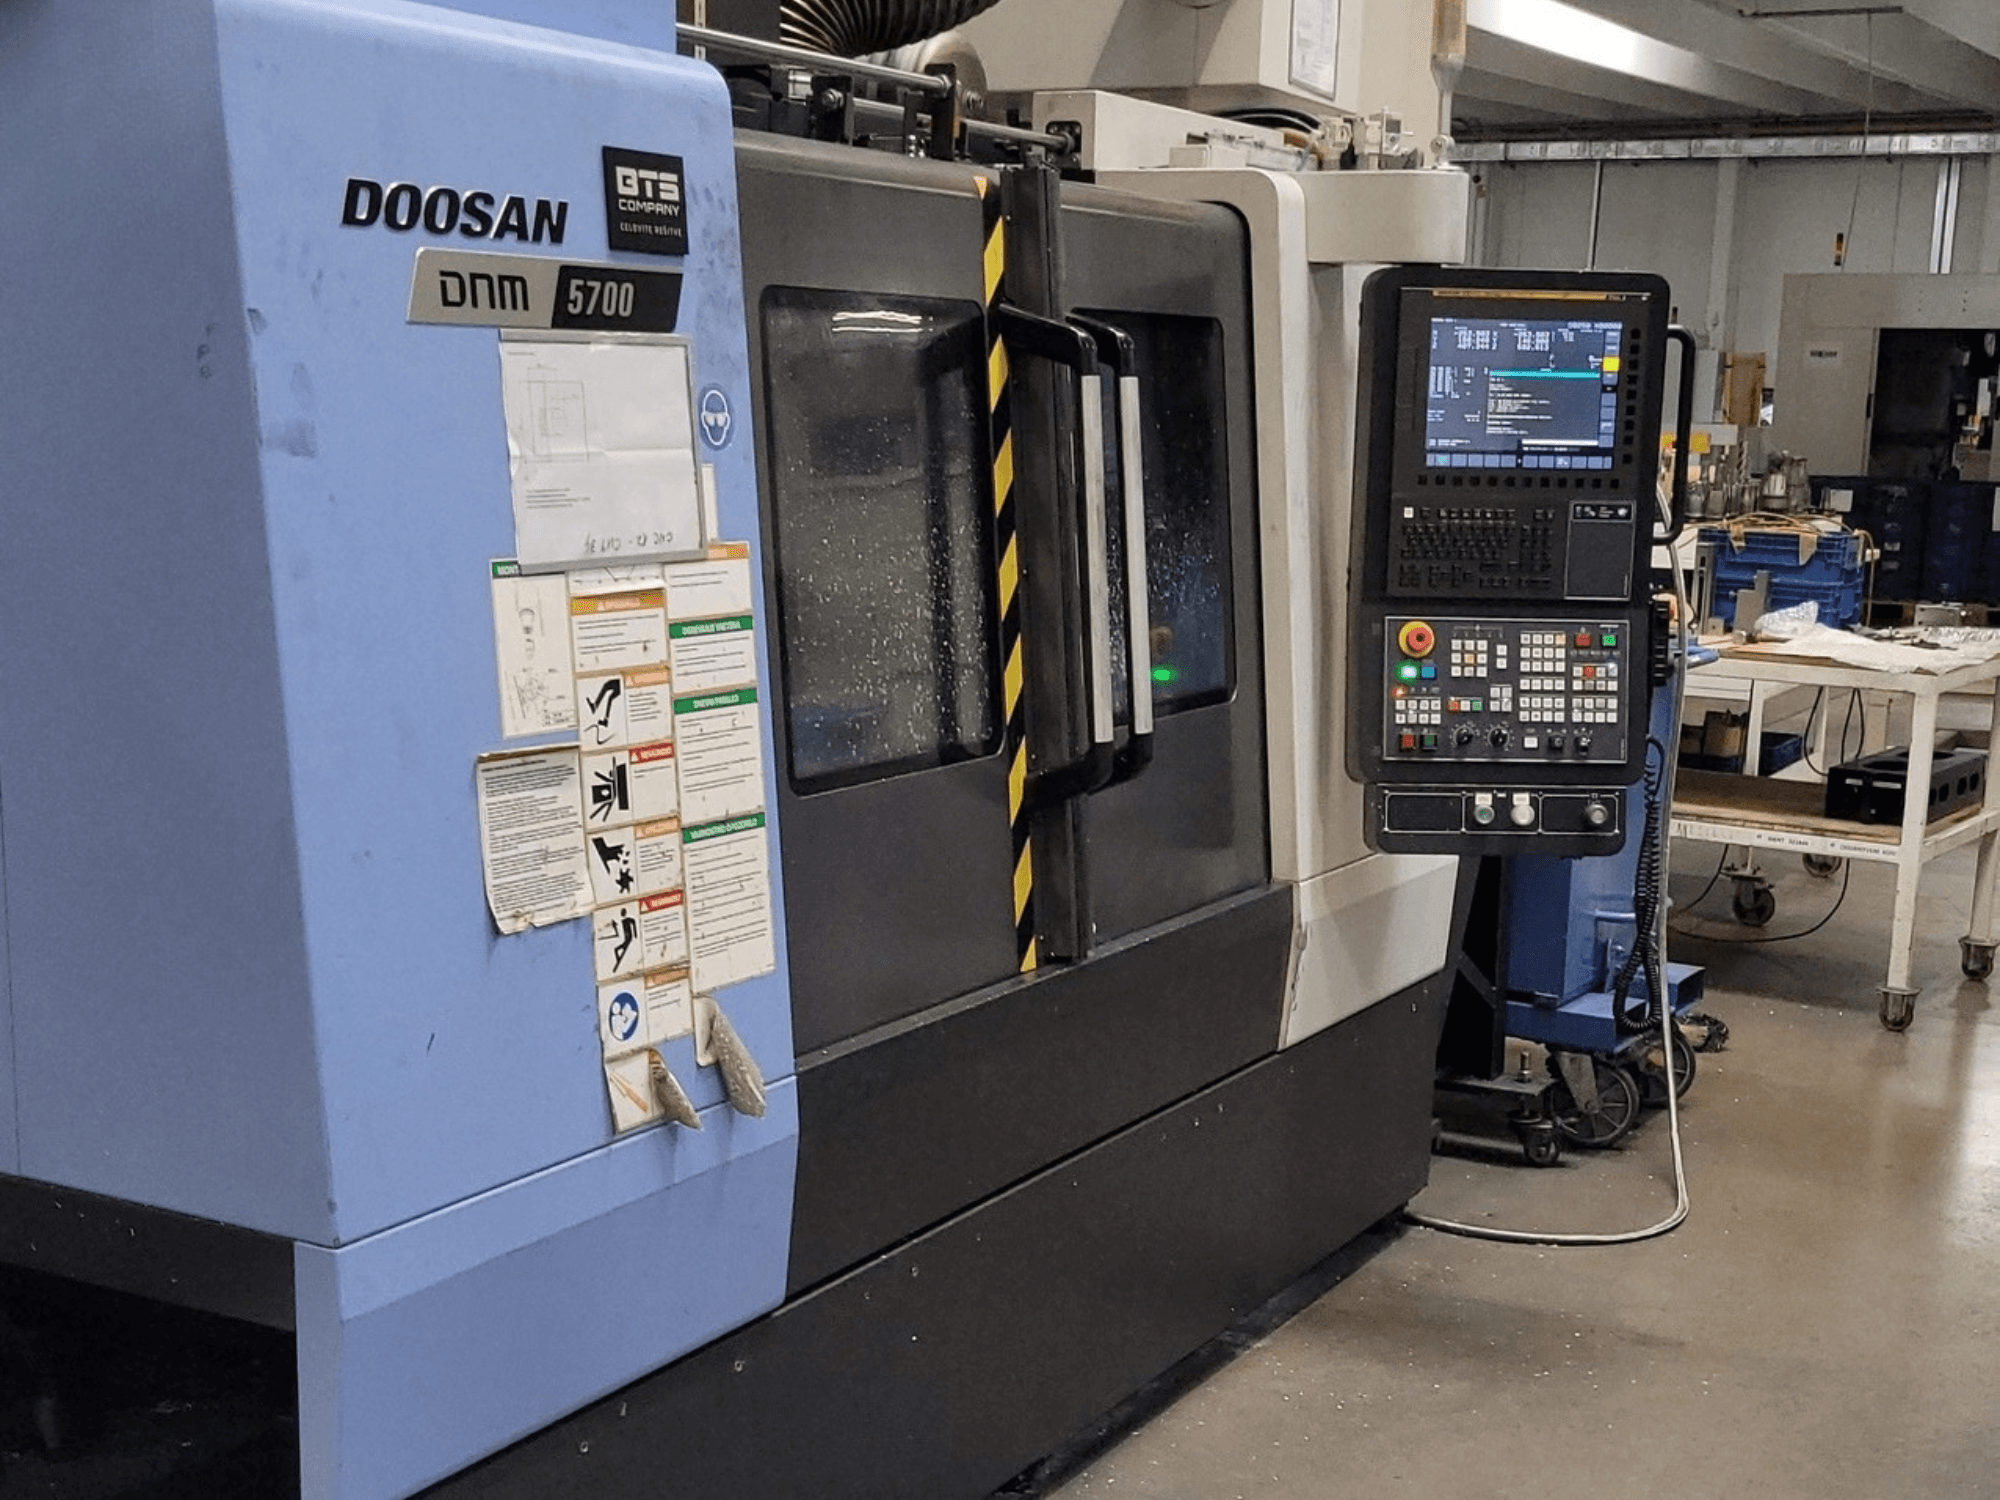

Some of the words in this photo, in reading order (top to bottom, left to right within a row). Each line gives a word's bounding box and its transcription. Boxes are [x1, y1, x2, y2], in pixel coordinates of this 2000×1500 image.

[616, 166, 680, 202] BTS
[341, 178, 568, 244] DOOSAN
[618, 198, 680, 217] COMPANY
[567, 278, 635, 318] 5700
